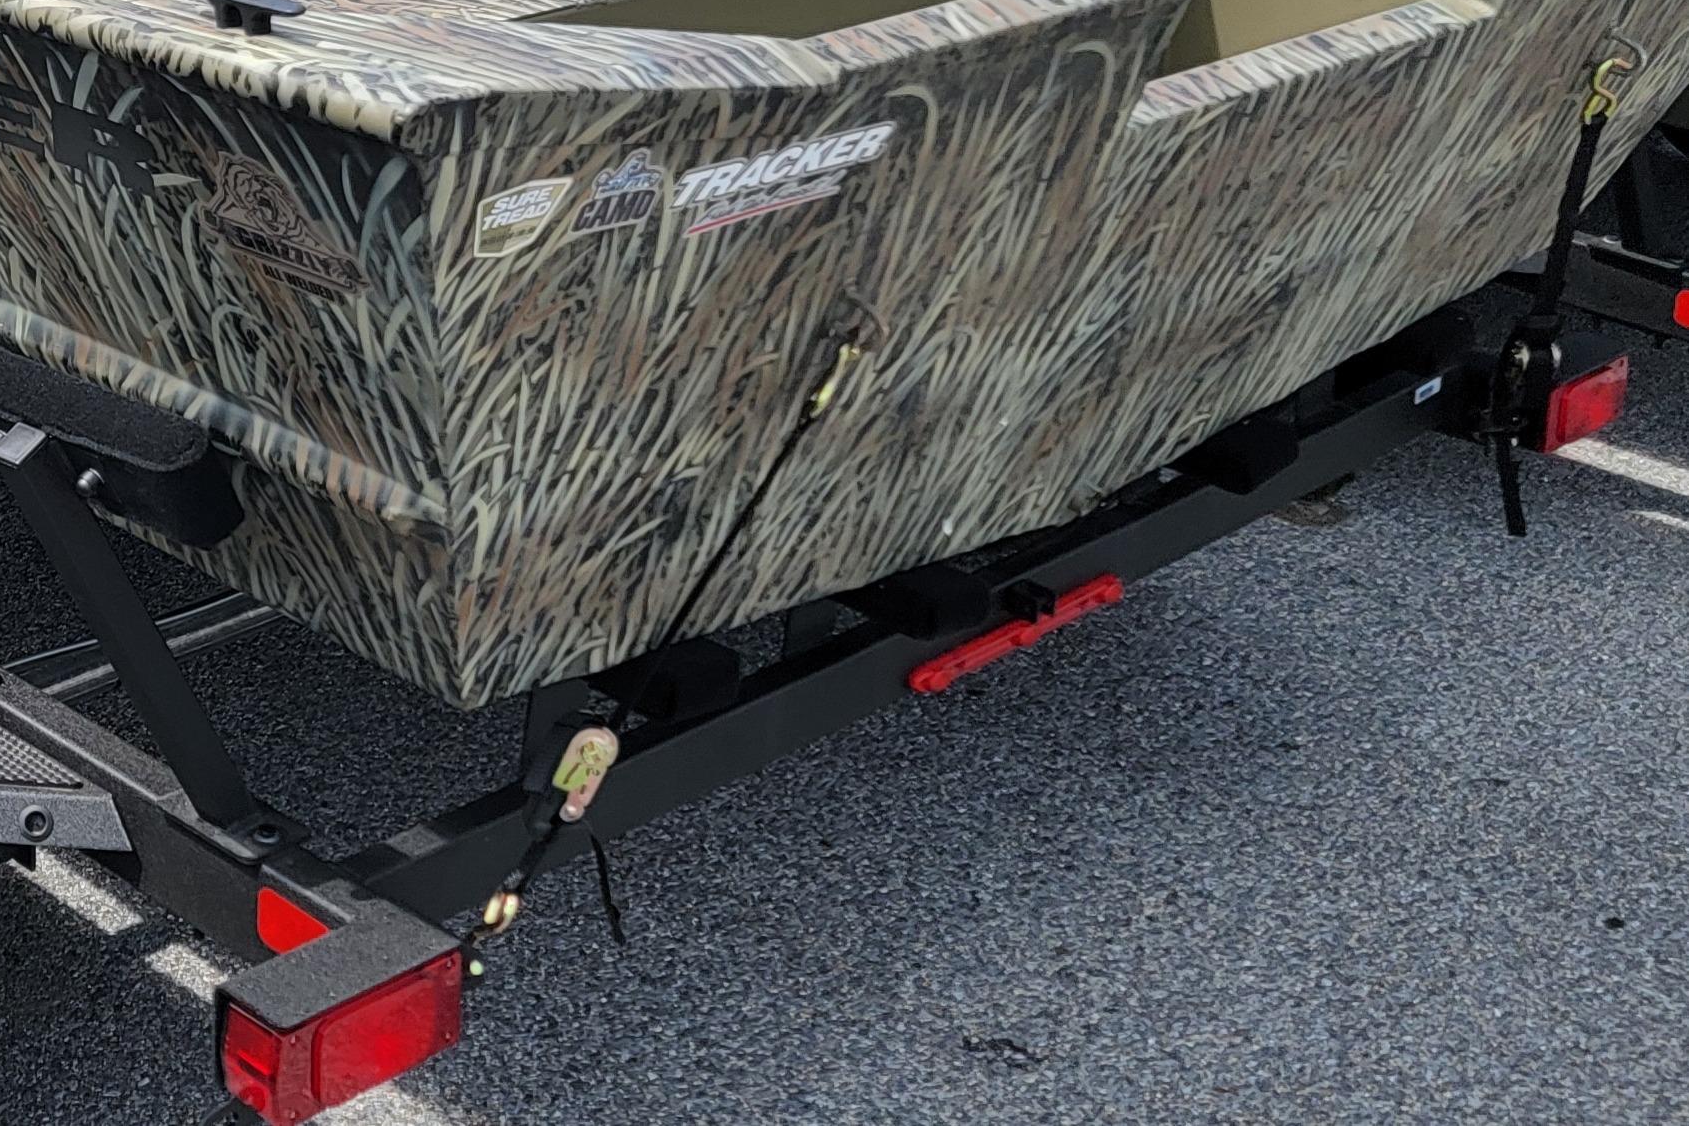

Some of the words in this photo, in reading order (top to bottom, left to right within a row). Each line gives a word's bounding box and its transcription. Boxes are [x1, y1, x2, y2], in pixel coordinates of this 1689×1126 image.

[672, 126, 894, 208] TRACKER
[482, 201, 552, 231] TREAD
[490, 186, 554, 215] SURE
[571, 190, 656, 232] CAMO
[263, 263, 284, 283] ALL
[284, 270, 334, 302] WELDED
